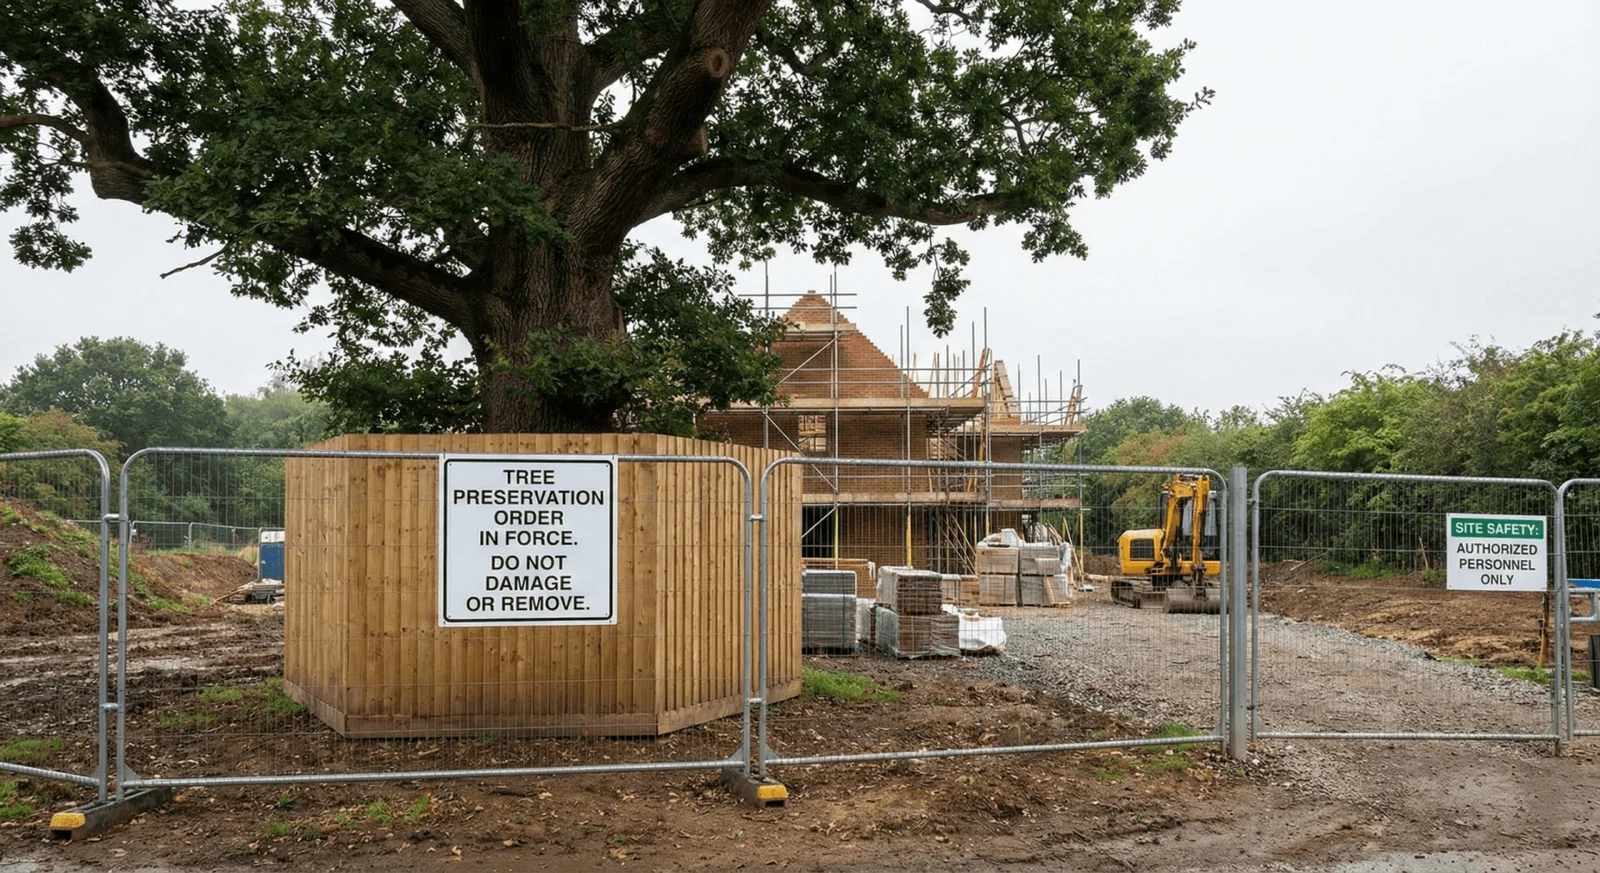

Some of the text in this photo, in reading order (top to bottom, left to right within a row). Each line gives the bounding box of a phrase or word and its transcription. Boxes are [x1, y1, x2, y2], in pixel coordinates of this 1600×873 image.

[503, 469, 555, 485] TREE
[453, 489, 604, 505] PRESERVATION
[494, 510, 564, 525] ORDER
[1455, 522, 1539, 535] SITE SAFETY:
[479, 530, 578, 546] IN FORCE.
[1456, 543, 1538, 555] AUTHORIZED
[491, 555, 567, 570] DO NOT
[1459, 558, 1536, 571] PERSONNEL
[485, 575, 572, 591] DAMAGE
[1480, 574, 1514, 585] ONLY
[466, 595, 590, 612] OR REMOVE.
